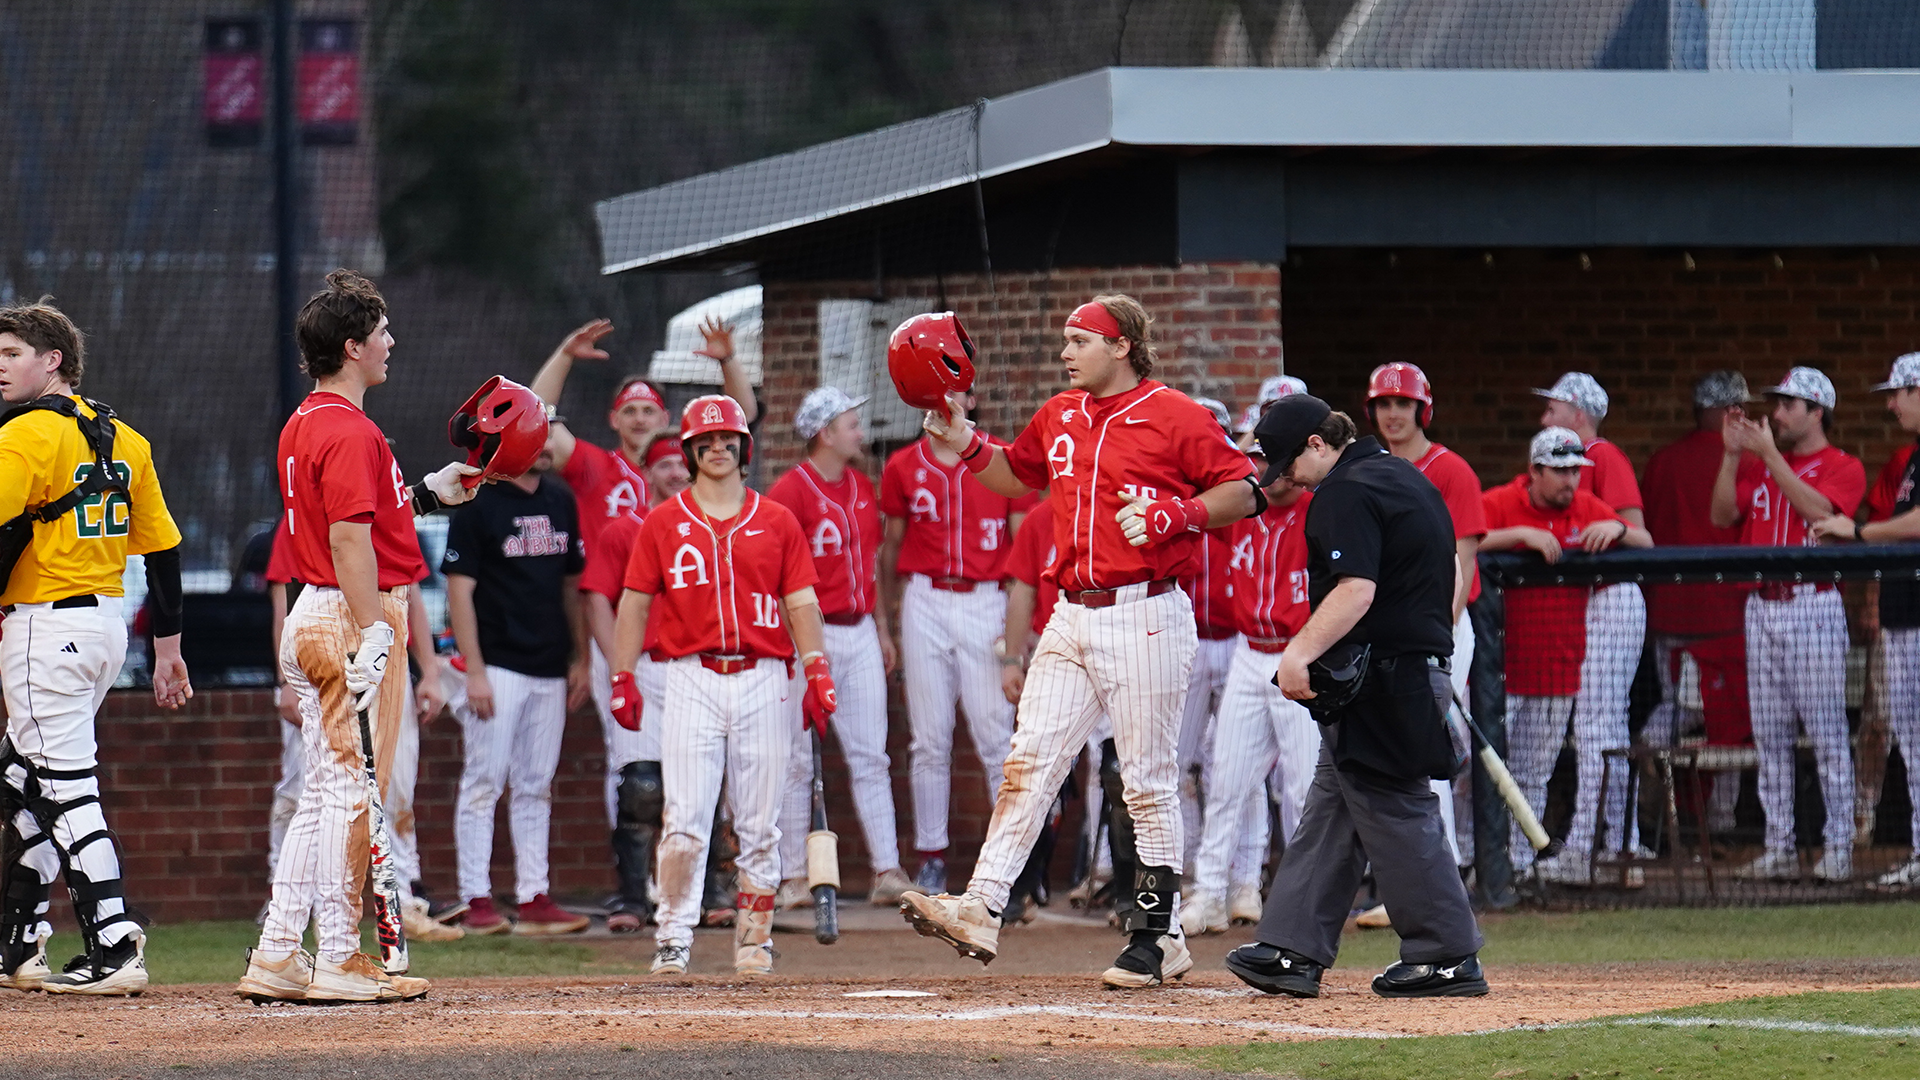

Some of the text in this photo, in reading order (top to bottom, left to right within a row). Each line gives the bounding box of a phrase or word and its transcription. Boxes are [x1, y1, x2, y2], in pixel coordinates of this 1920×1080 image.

[702, 402, 724, 425] A
[1048, 433, 1075, 480] A
[73, 460, 132, 539] 22
[605, 480, 638, 518] A
[910, 487, 941, 522] A
[512, 515, 555, 534] THE
[811, 518, 842, 557] A
[502, 531, 569, 558] ABBEY
[1230, 533, 1255, 578] A
[669, 543, 710, 589] A
[751, 591, 780, 628] 10
